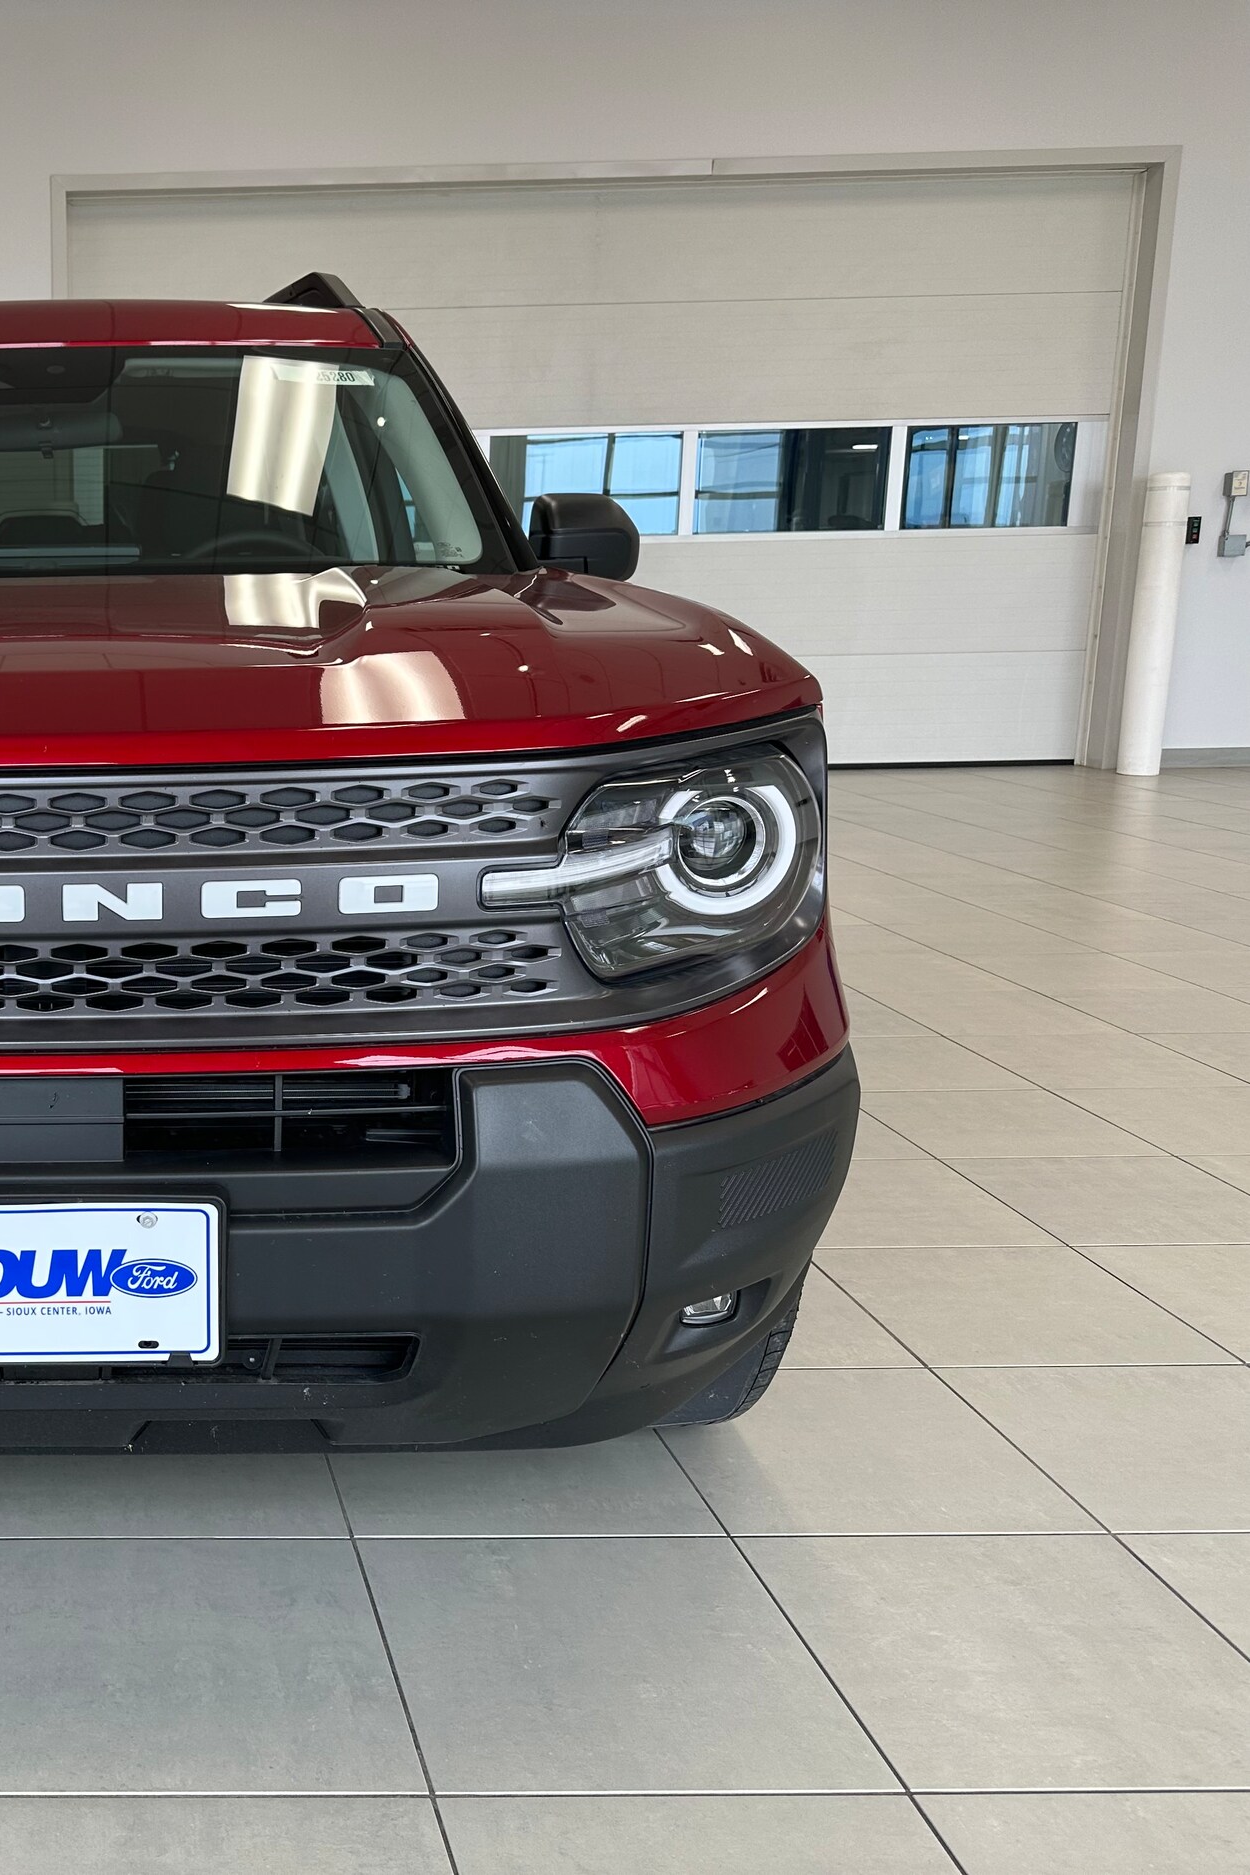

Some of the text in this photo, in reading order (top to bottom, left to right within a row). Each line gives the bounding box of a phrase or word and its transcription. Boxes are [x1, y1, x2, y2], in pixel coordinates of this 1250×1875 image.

[127, 1265, 177, 1290] Ford
[6, 1307, 37, 1316] SIOUX
[85, 1306, 112, 1315] IOWA
